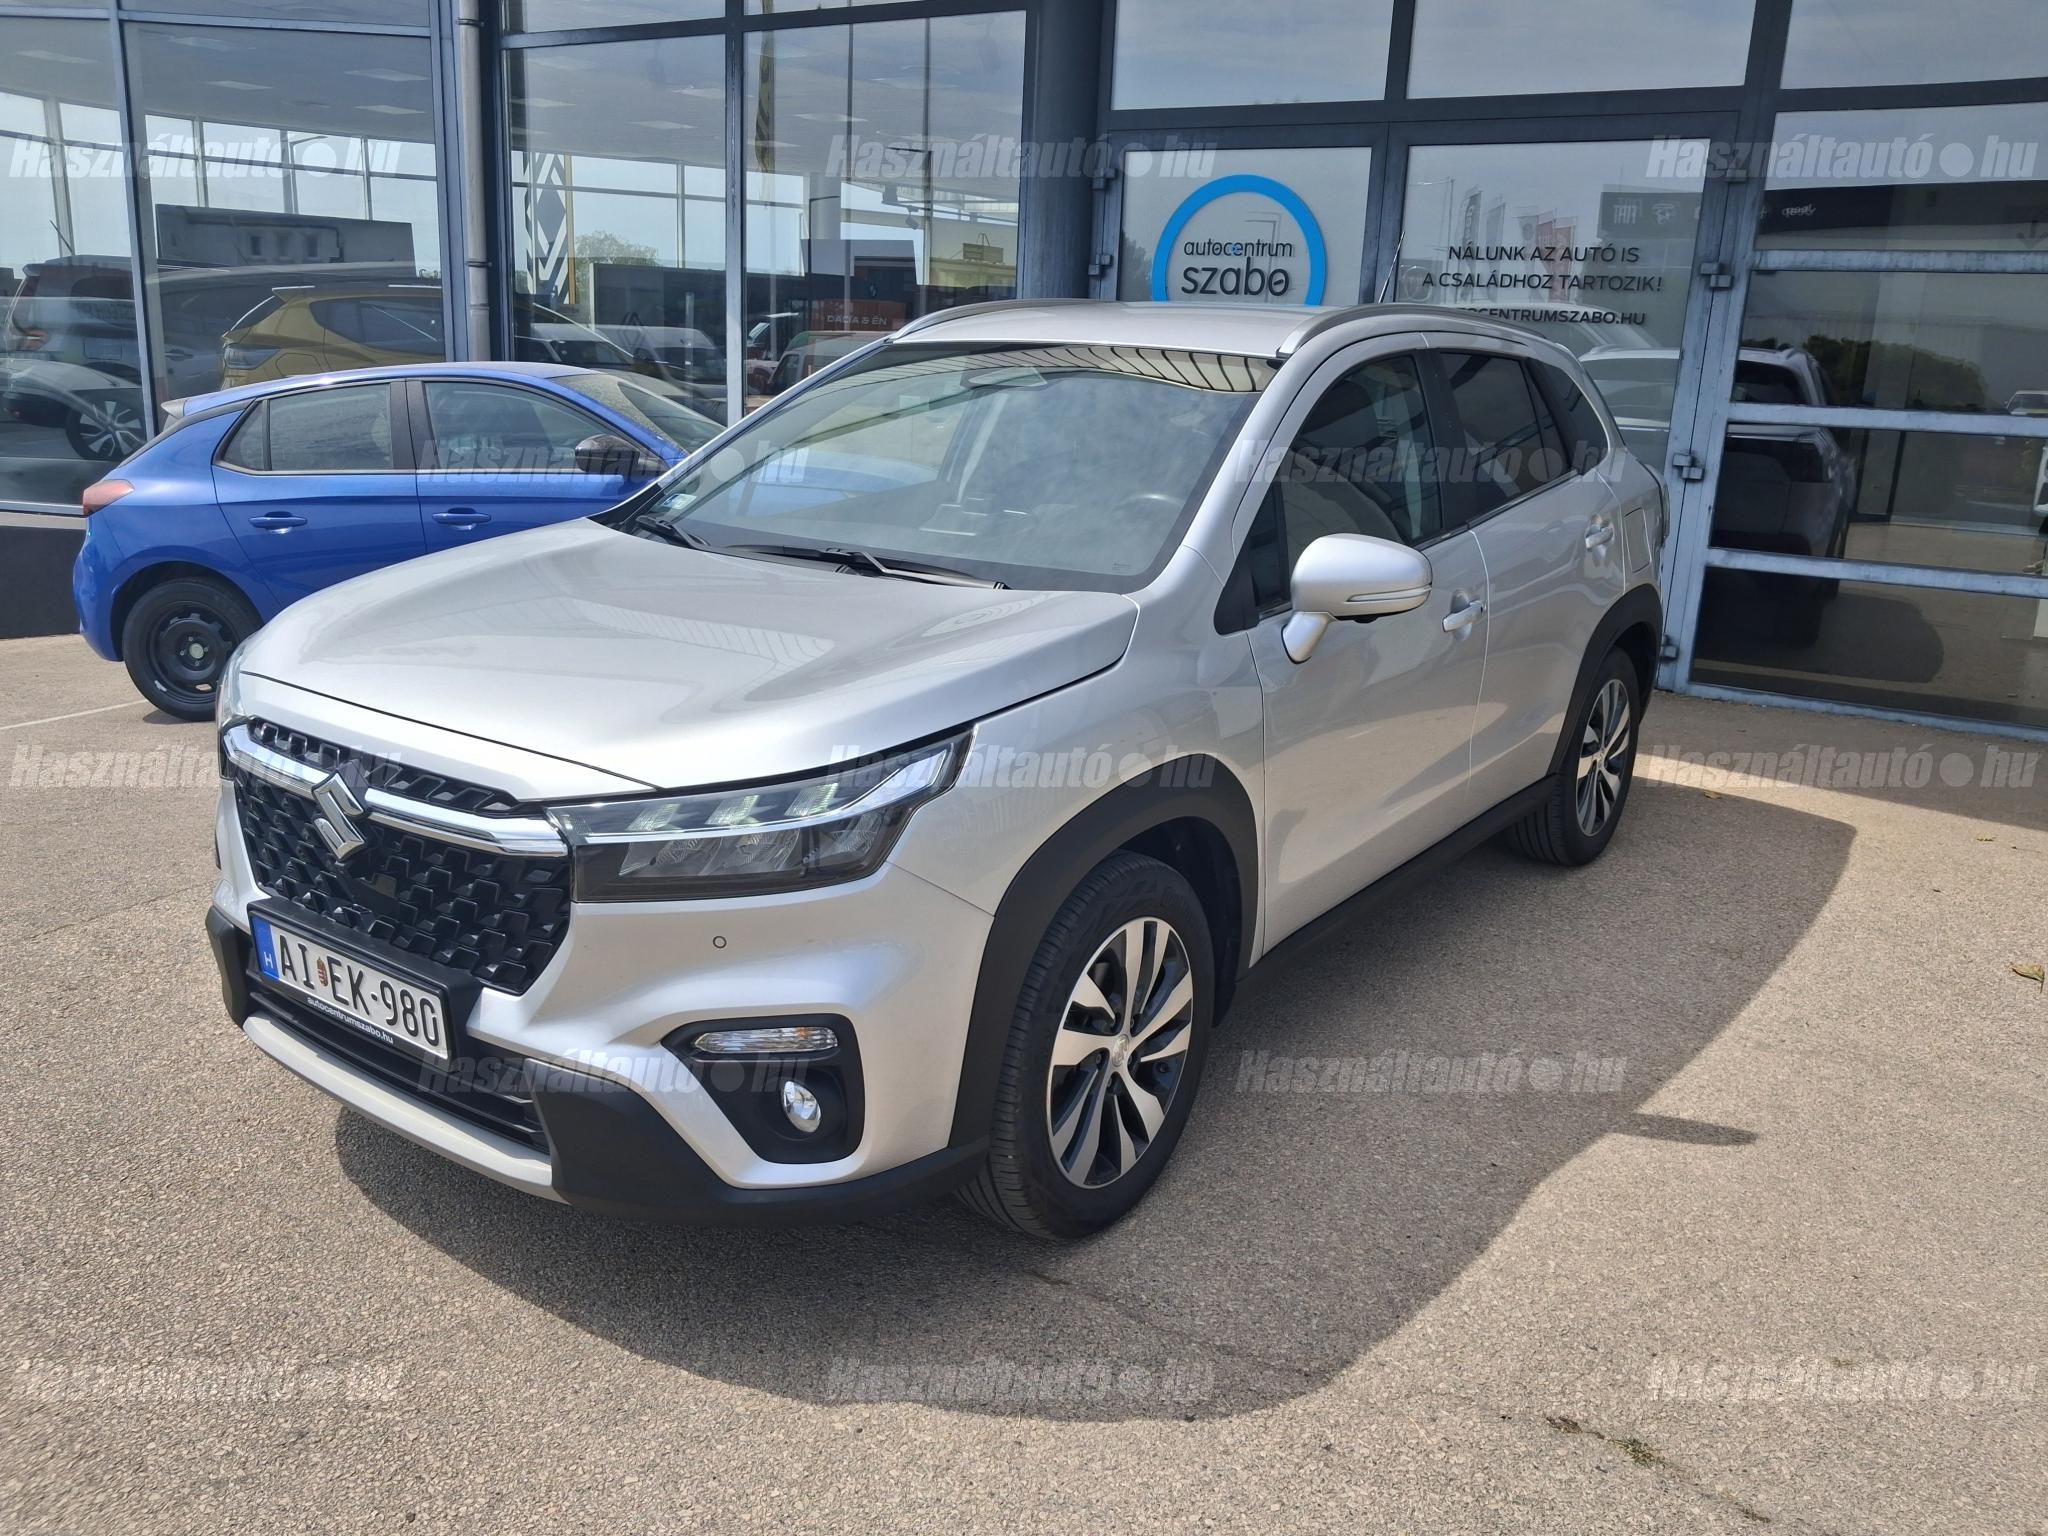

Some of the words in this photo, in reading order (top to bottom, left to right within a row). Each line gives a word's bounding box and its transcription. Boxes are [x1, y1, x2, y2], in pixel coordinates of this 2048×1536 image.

[1184, 238, 1293, 257] autocentrum
[1449, 242, 1525, 261] NÁLUNK
[1530, 246, 1556, 262] AZ
[1560, 244, 1616, 263] AUTÓ
[1621, 247, 1640, 263] IS
[1181, 256, 1290, 297] szabo
[1422, 272, 1434, 287] A
[1438, 270, 1553, 289] CSALÁDHOZ
[1558, 274, 1663, 292] TARTOZIK!
[1457, 307, 1646, 325] ENTRUMSZABO.HU
[263, 951, 275, 970] H
[279, 934, 316, 990] AI
[307, 997, 394, 1045] autocentrumszabo.hu
